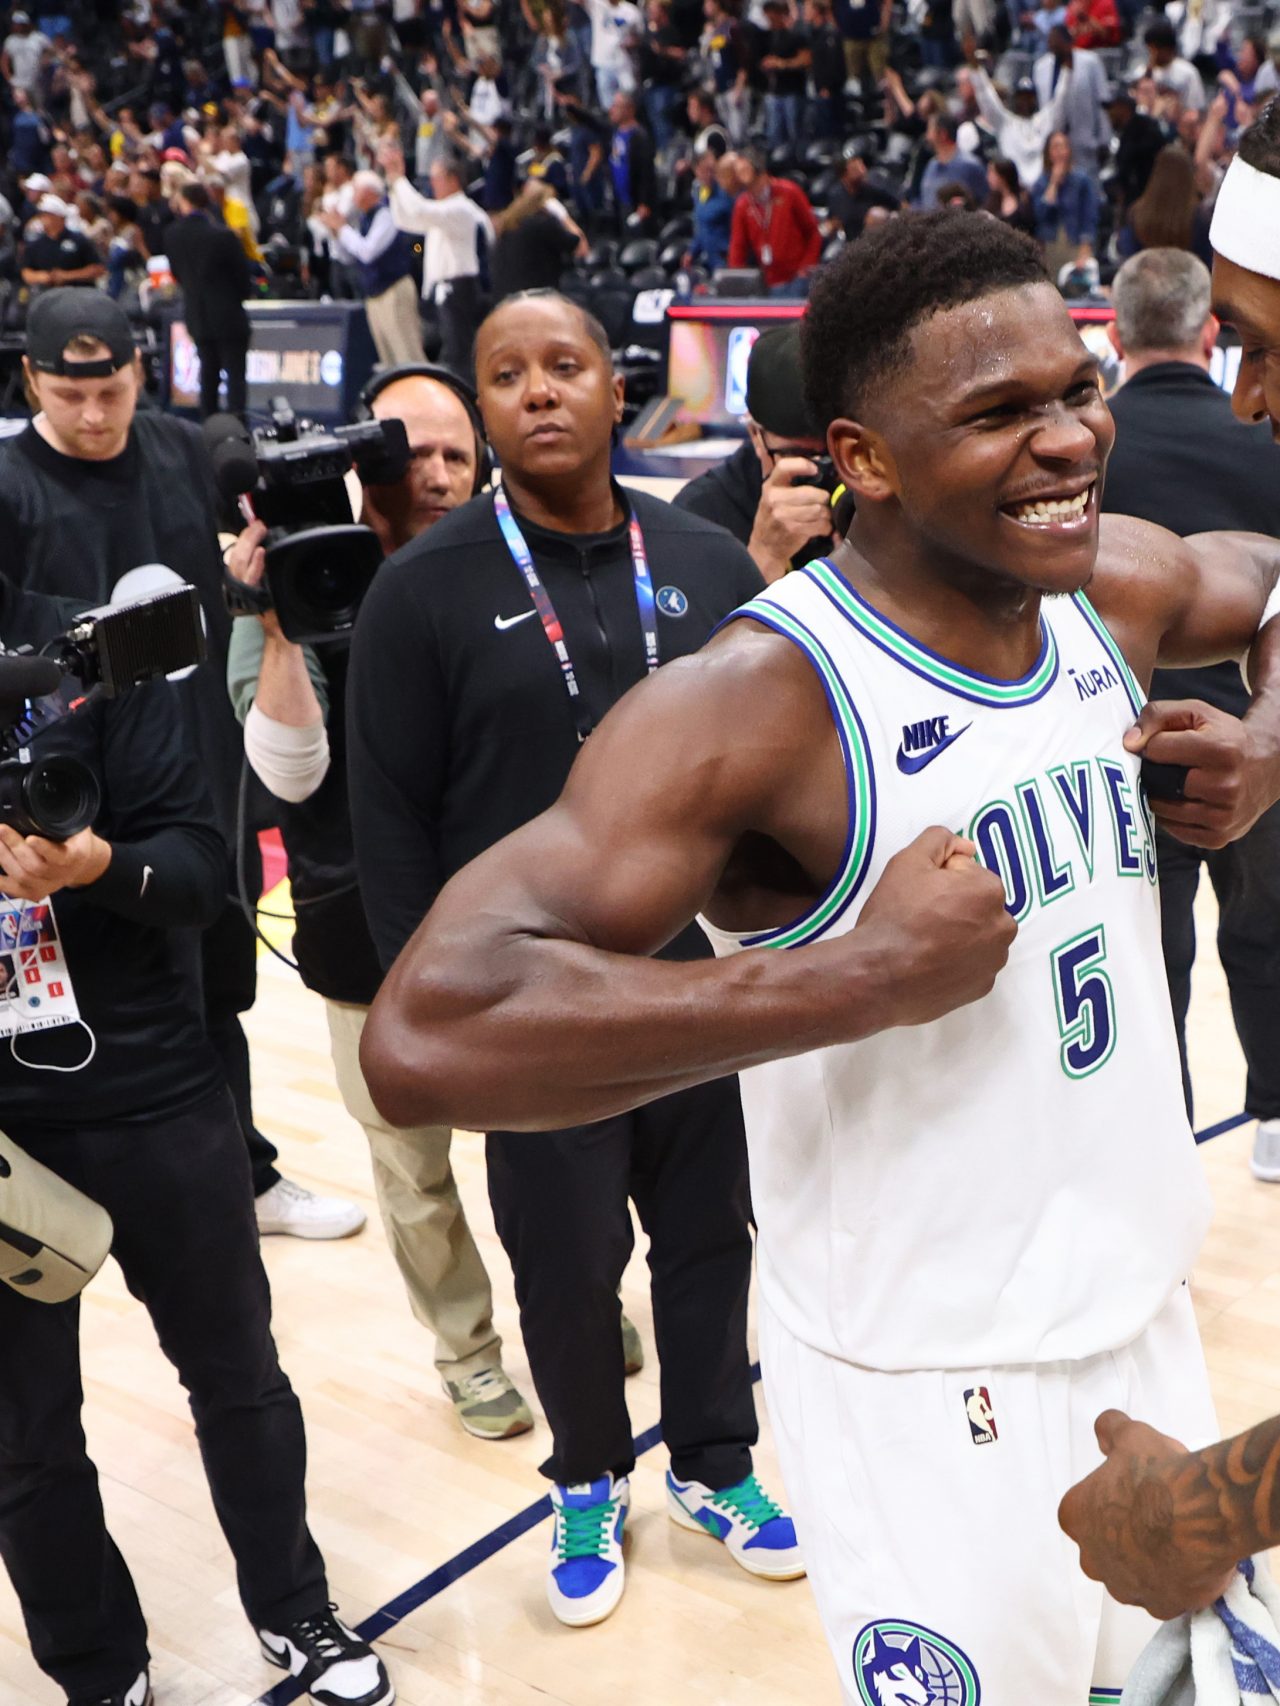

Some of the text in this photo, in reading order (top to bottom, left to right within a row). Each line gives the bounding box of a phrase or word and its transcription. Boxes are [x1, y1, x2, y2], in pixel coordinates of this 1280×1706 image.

[902, 715, 949, 752] NIKE
[1050, 923, 1117, 1080] 5
[974, 1432, 991, 1443] NBA
